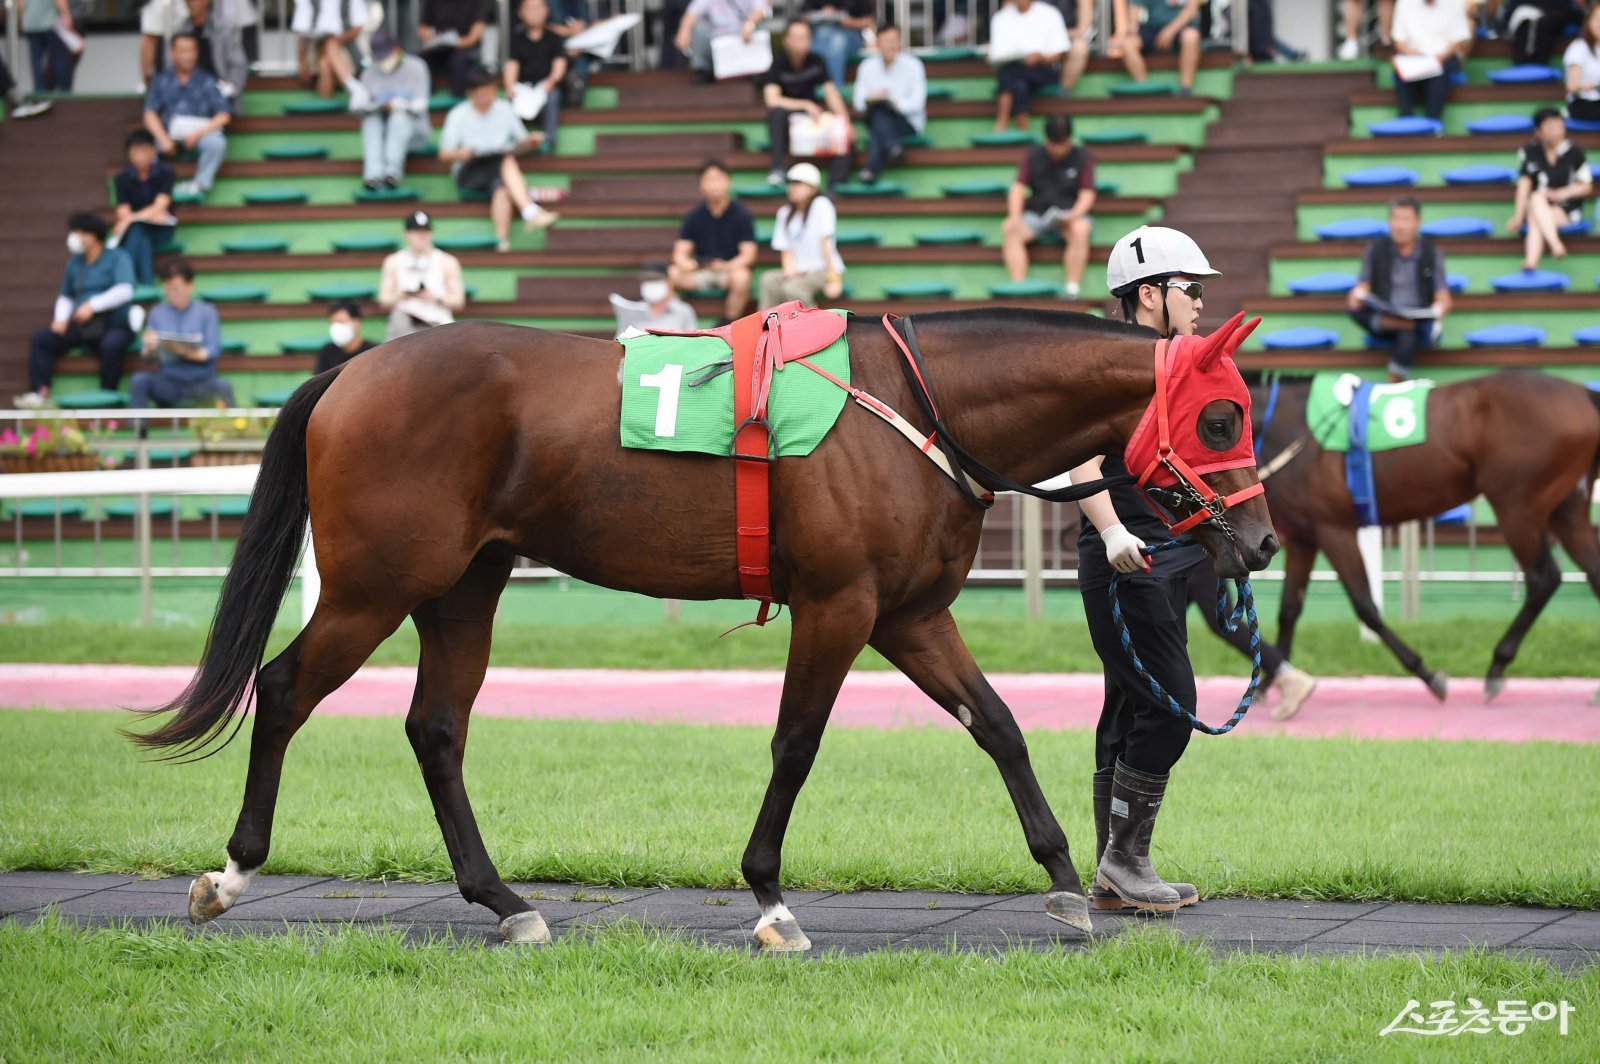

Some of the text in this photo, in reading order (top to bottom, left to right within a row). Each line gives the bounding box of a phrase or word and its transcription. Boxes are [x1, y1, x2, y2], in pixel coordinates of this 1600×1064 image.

[1129, 237, 1146, 265] 1
[639, 363, 684, 438] 1
[1383, 396, 1417, 439] 6
